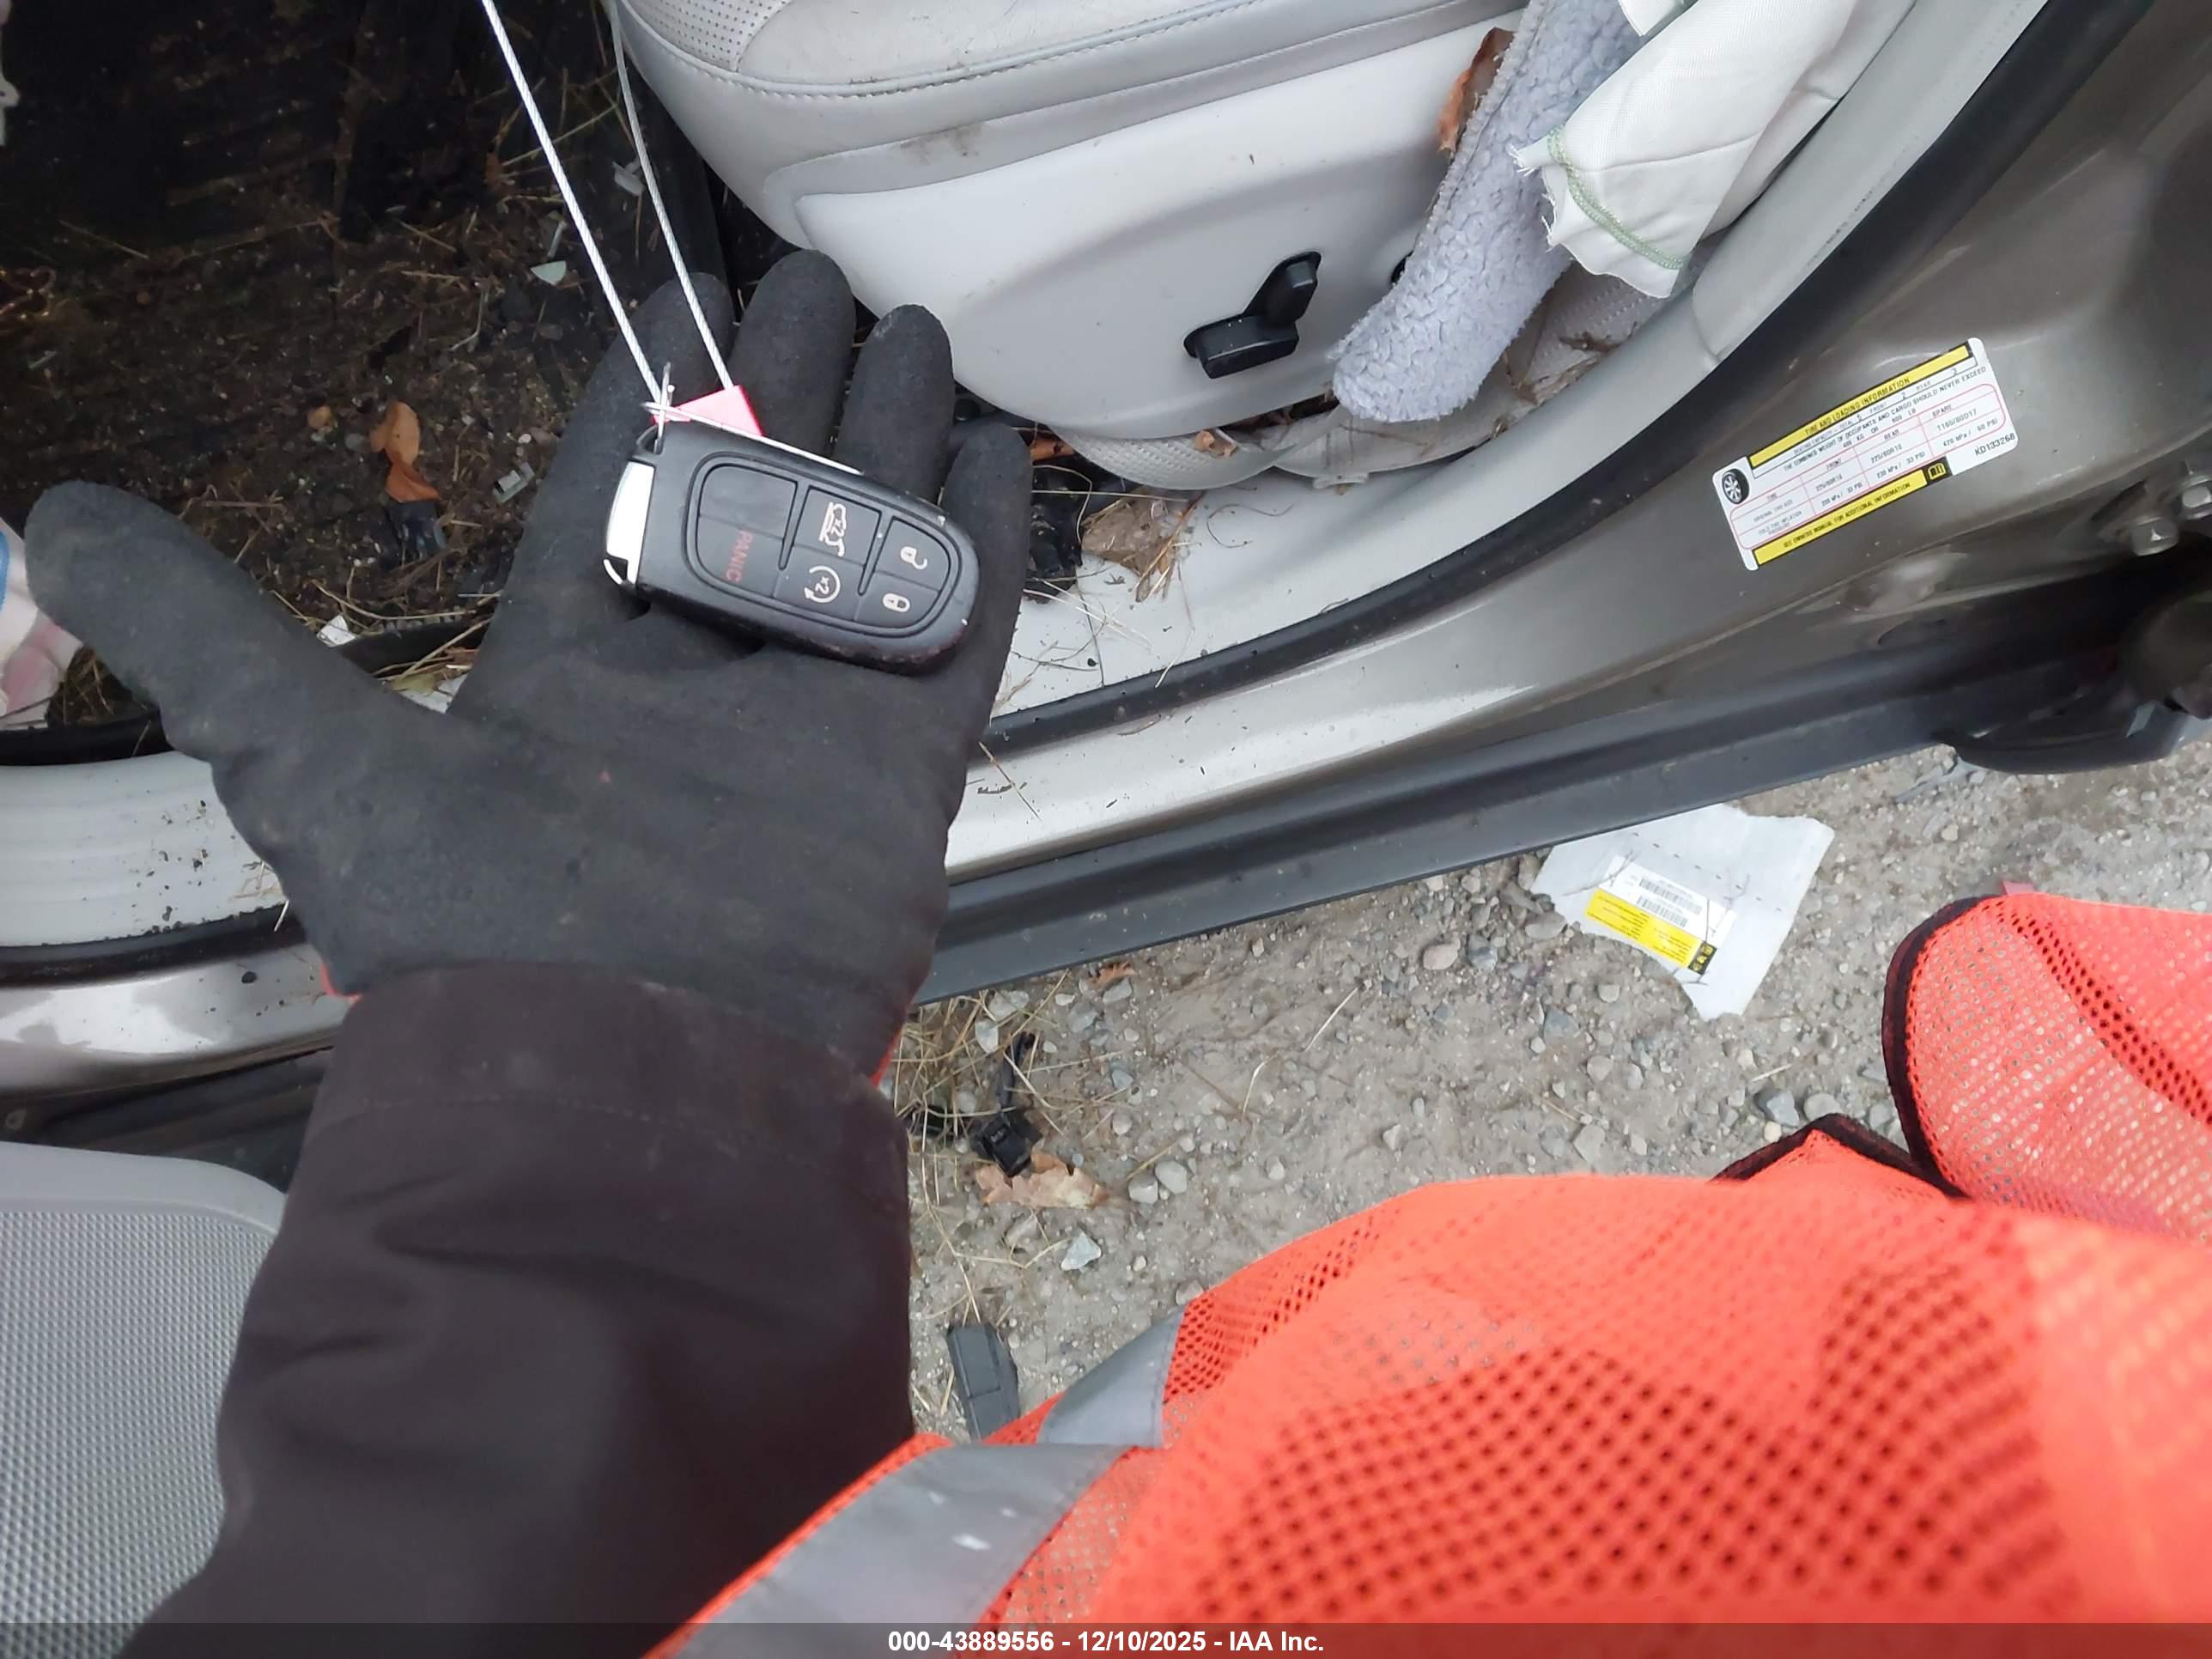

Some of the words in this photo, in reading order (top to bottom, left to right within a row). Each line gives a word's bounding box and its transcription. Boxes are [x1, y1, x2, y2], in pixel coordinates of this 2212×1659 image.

[1804, 423, 1818, 435] TIRE
[1818, 416, 1832, 428] AND
[1832, 401, 1860, 420] LOADING
[1861, 375, 1910, 405] INFORMATION
[1844, 418, 1876, 438] OCCUPANTS
[1877, 411, 1889, 422] AND
[1891, 401, 1911, 416] CARGO
[1912, 388, 1938, 405] SHOULD
[1939, 378, 1960, 393] NEVER
[1961, 365, 1986, 382] EXCEED
[725, 529, 754, 582] PANIC
[814, 575, 830, 595] x2
